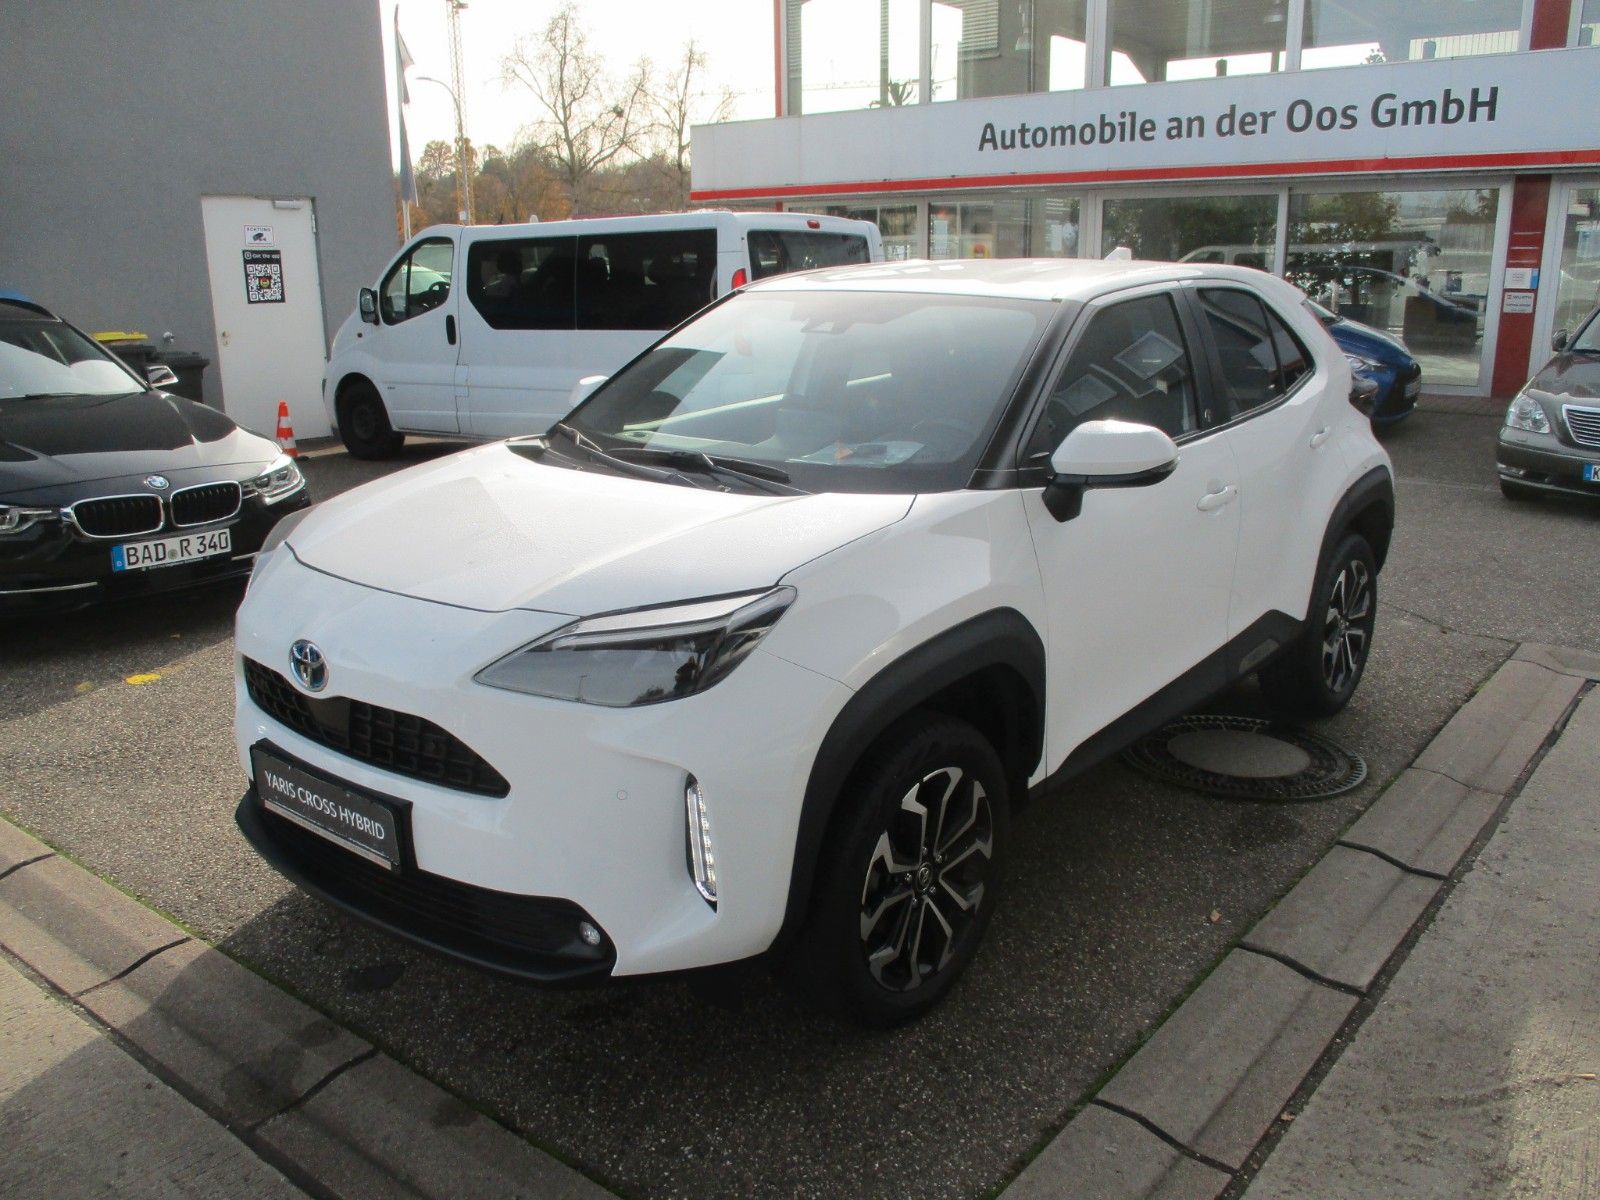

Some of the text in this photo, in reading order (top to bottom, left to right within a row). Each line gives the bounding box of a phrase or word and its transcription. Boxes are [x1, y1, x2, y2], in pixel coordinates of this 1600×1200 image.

[978, 86, 1499, 152] Automobile an der Oos GmbH
[126, 542, 167, 566] BAD
[180, 538, 192, 557] R
[197, 531, 229, 554] 340
[264, 770, 385, 840] YARIS CROSS HYBRID
